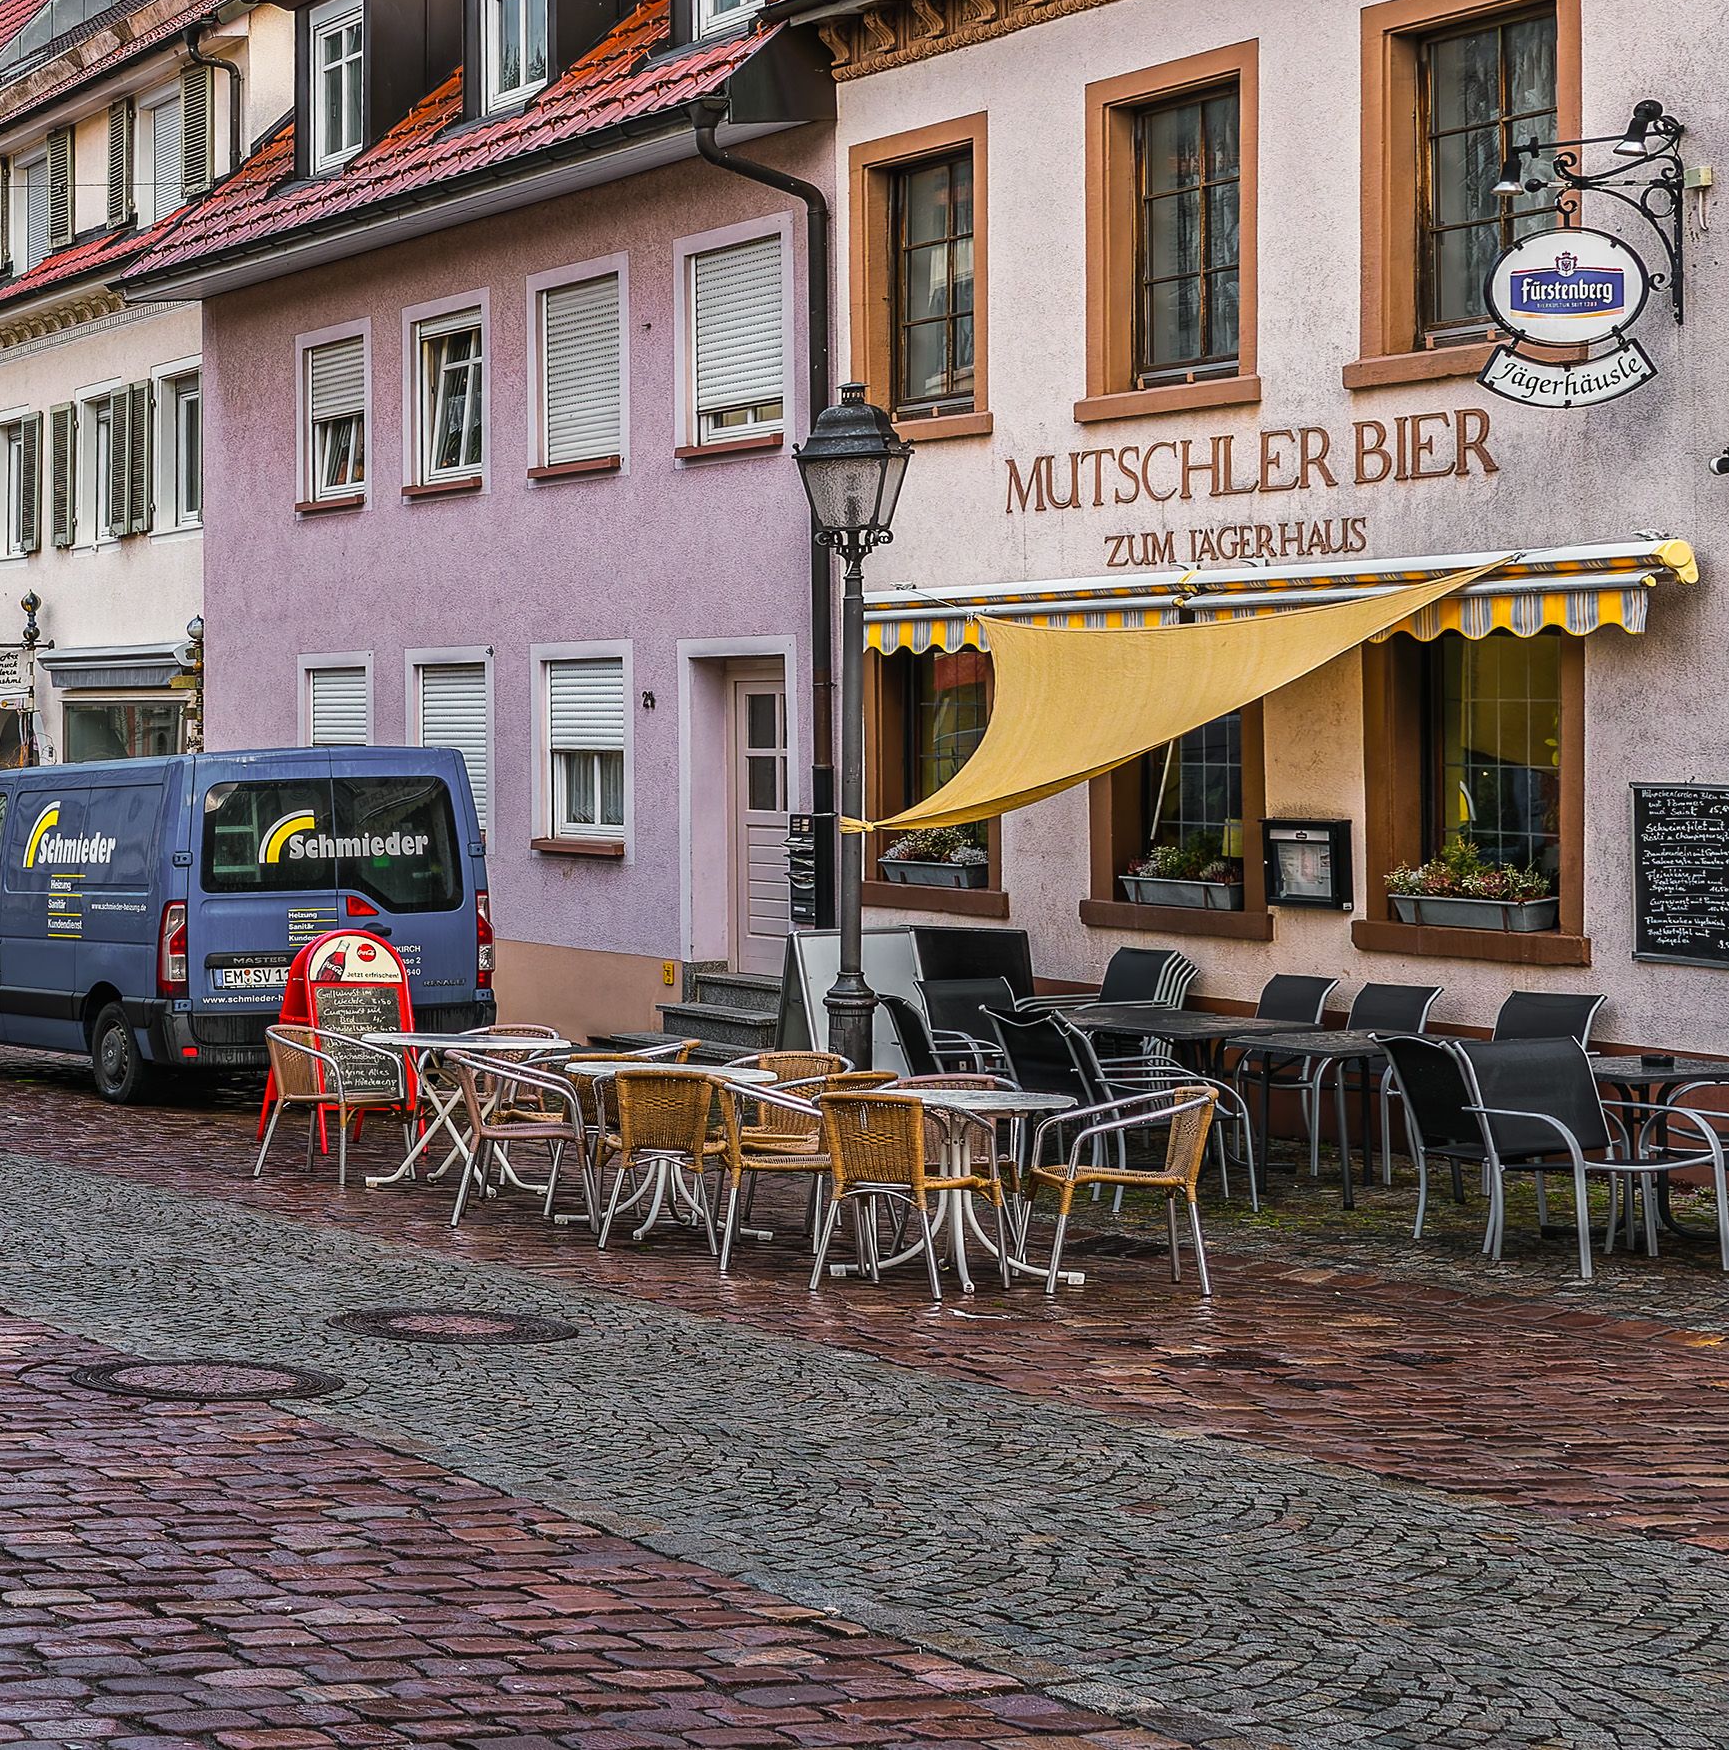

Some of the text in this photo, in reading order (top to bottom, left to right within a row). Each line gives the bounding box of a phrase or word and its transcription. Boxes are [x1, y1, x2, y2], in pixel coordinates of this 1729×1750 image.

[1521, 278, 1613, 303] Fürstenberg
[1491, 355, 1643, 399] Jägerhäusle
[1004, 406, 1500, 514] MUTSCHLER BIER
[1104, 516, 1369, 568] ZUM JÄGERHAUS
[0, 652, 19, 662] Art
[38, 831, 117, 864] Schmieder
[288, 831, 429, 860] Schmieder
[50, 879, 72, 891] Heizung
[48, 899, 67, 910] Sanitär
[288, 911, 318, 919] Heizung
[47, 918, 83, 930] Kundendienst
[232, 956, 288, 964] MASTER
[416, 956, 422, 964] 2
[224, 970, 244, 984] EM
[253, 969, 272, 983] SV
[202, 994, 285, 1004] www.schmieder-h
